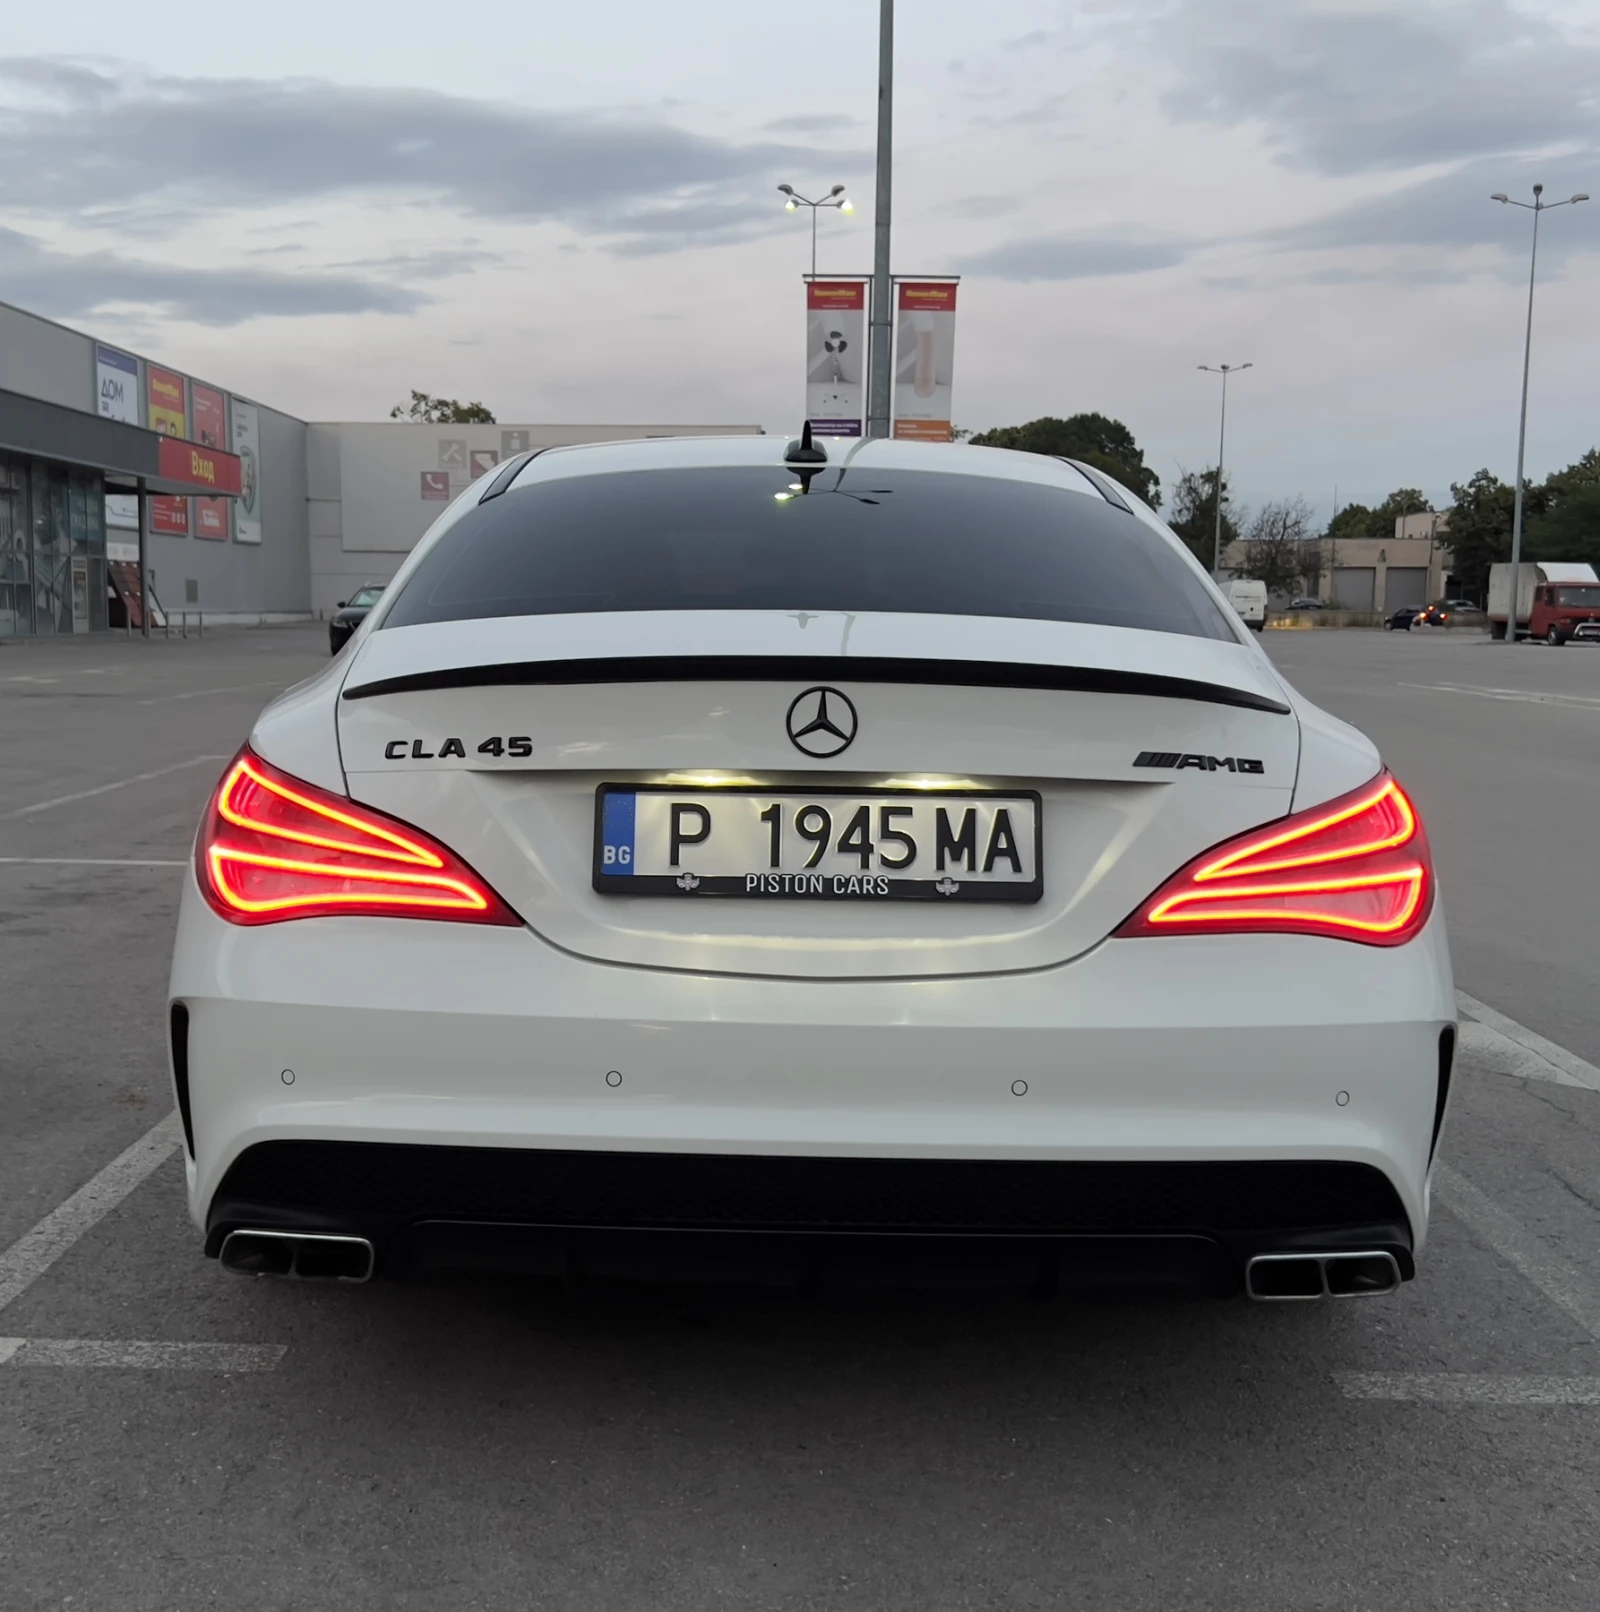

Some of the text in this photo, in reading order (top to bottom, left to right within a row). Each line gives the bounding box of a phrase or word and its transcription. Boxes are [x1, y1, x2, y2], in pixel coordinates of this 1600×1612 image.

[101, 376, 124, 403] ДОМ
[192, 450, 215, 484] Вход
[385, 736, 533, 759] CLA 45
[1175, 753, 1265, 774] AMG
[669, 803, 1022, 873] P 1945 MA
[603, 845, 631, 864] BG
[745, 873, 889, 895] PISTON CARS
